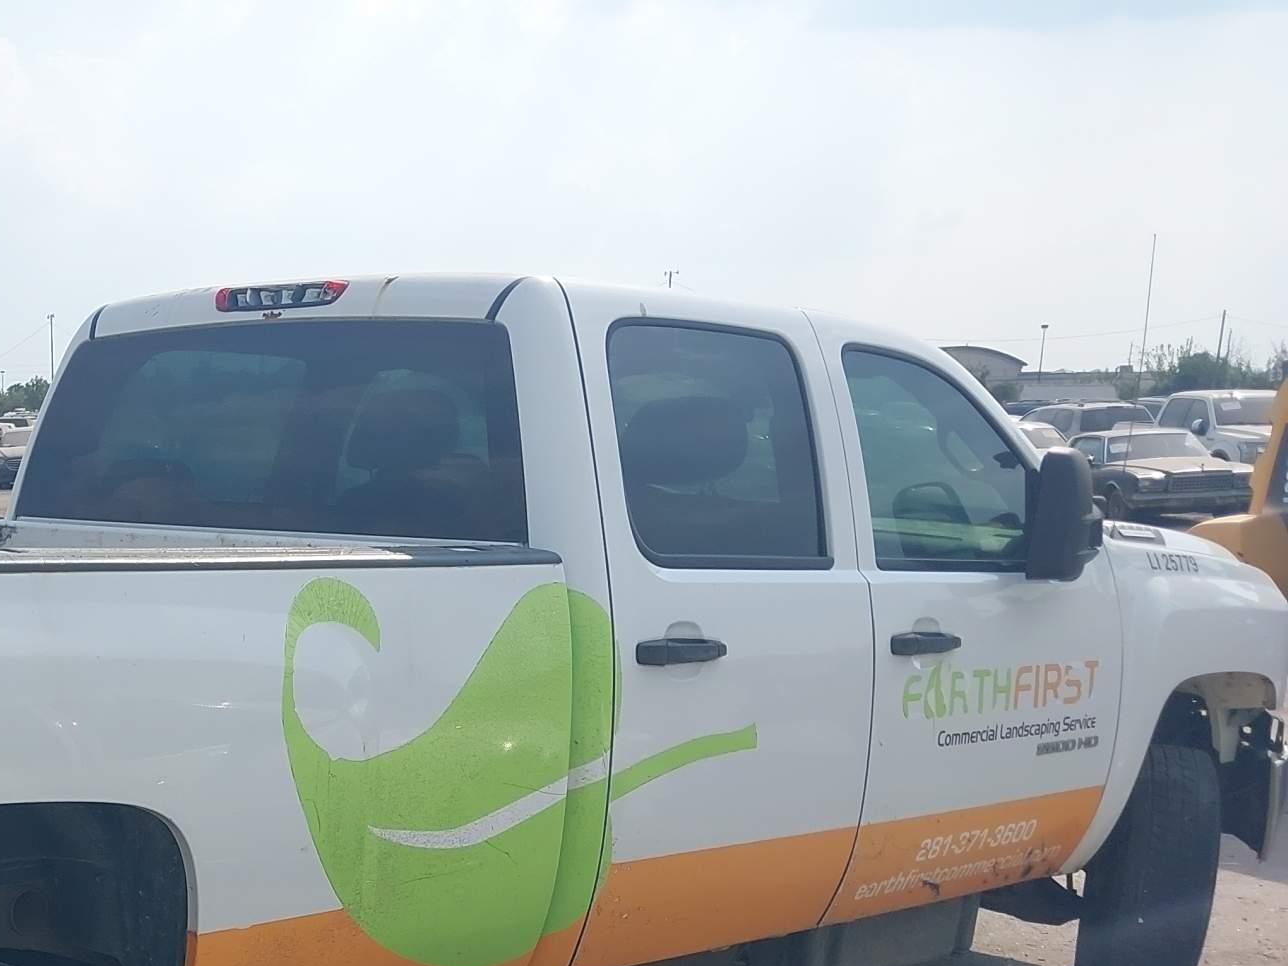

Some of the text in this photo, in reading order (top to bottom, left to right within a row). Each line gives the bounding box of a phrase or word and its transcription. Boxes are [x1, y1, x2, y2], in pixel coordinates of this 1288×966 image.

[1162, 554, 1199, 572] 25779
[937, 714, 1097, 747] Commercial Landscaping Service
[915, 819, 1038, 862] 281-371-3600
